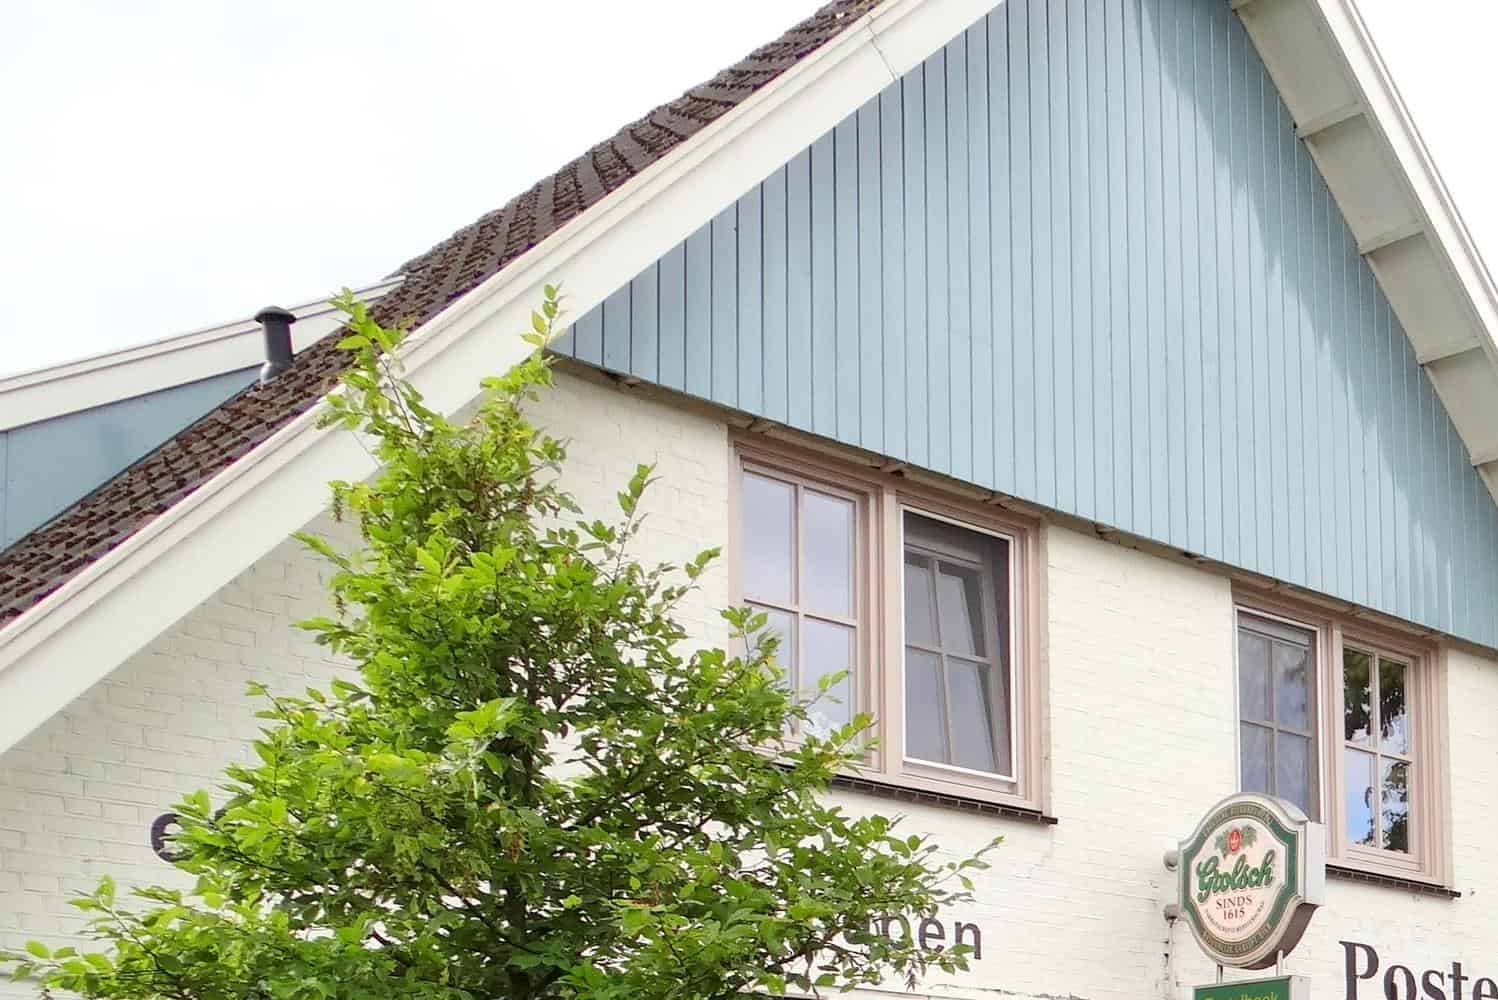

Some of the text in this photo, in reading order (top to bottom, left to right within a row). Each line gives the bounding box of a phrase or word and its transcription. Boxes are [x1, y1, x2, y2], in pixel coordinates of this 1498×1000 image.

[1196, 850, 1275, 903] Grolsch
[1216, 895, 1253, 910] SINDS
[1223, 907, 1245, 920] 1615
[863, 910, 982, 963] pen
